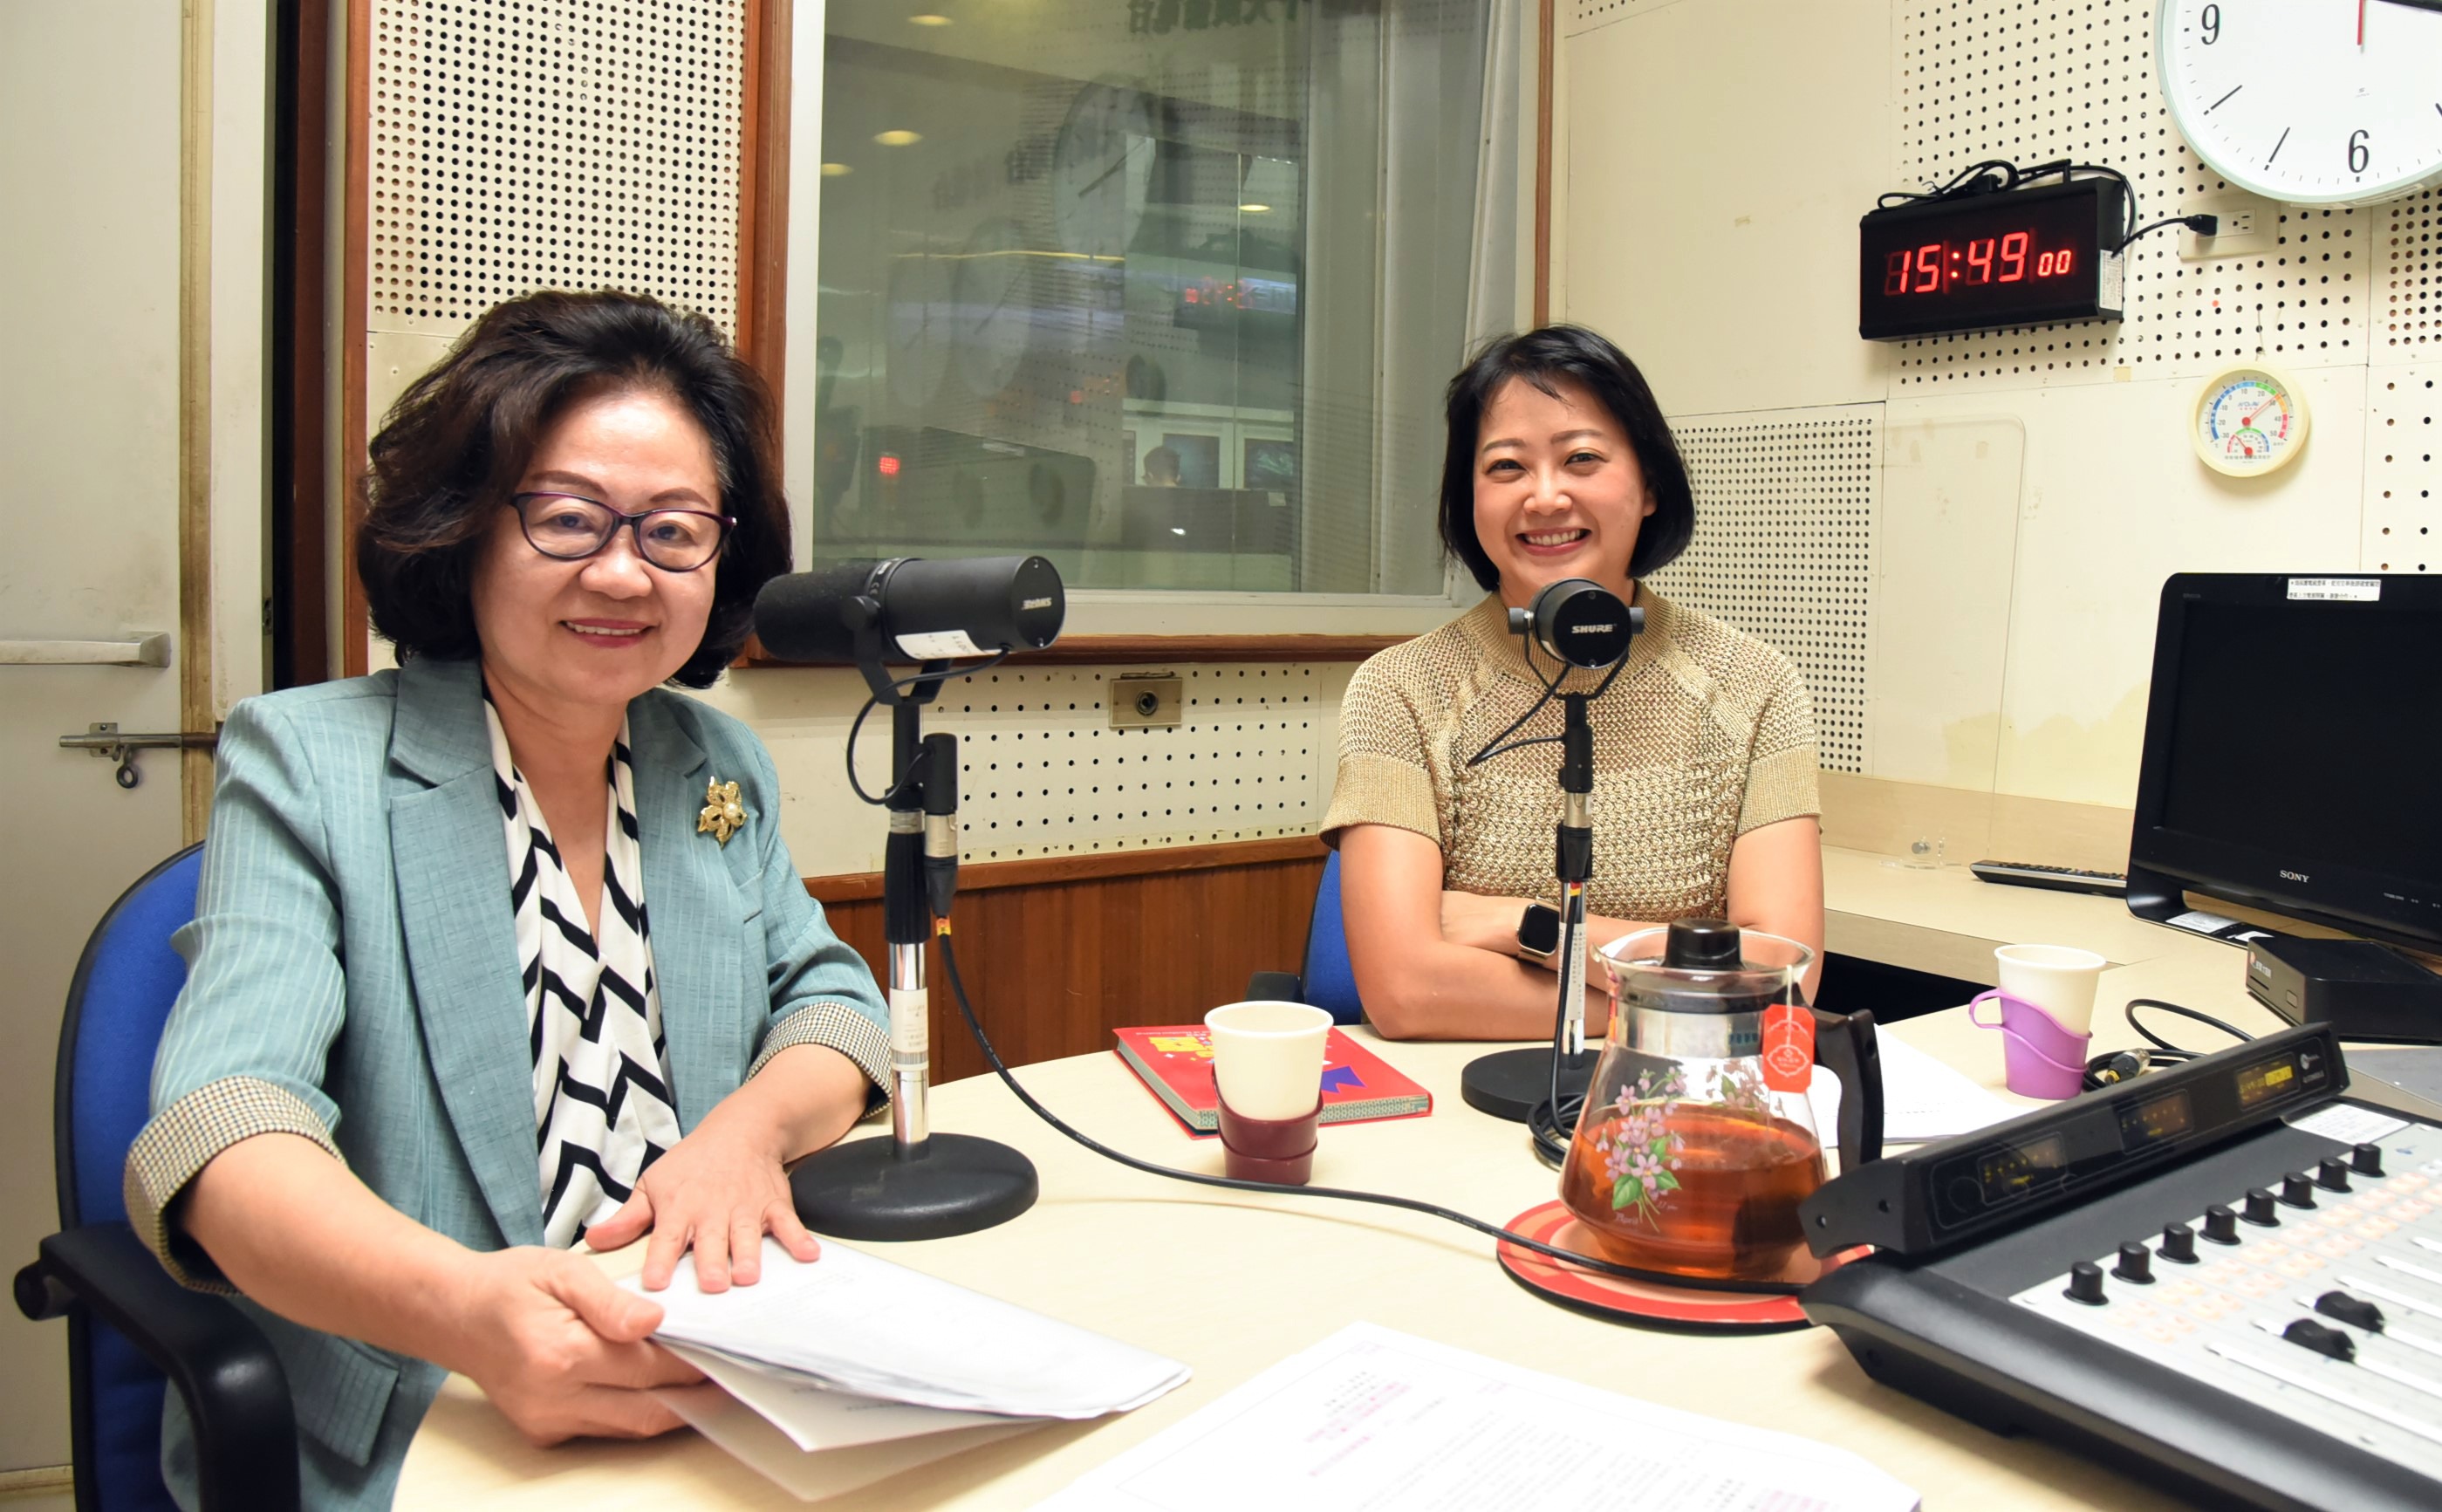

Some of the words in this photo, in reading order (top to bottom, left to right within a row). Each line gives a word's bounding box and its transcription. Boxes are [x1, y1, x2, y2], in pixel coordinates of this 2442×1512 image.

[2200, 3, 2221, 45] 9
[2348, 129, 2370, 174] 6
[1898, 230, 2029, 294] 15:49
[2037, 250, 2072, 277] 00
[1571, 623, 1614, 634] SHURE
[2279, 869, 2310, 883] SONY
